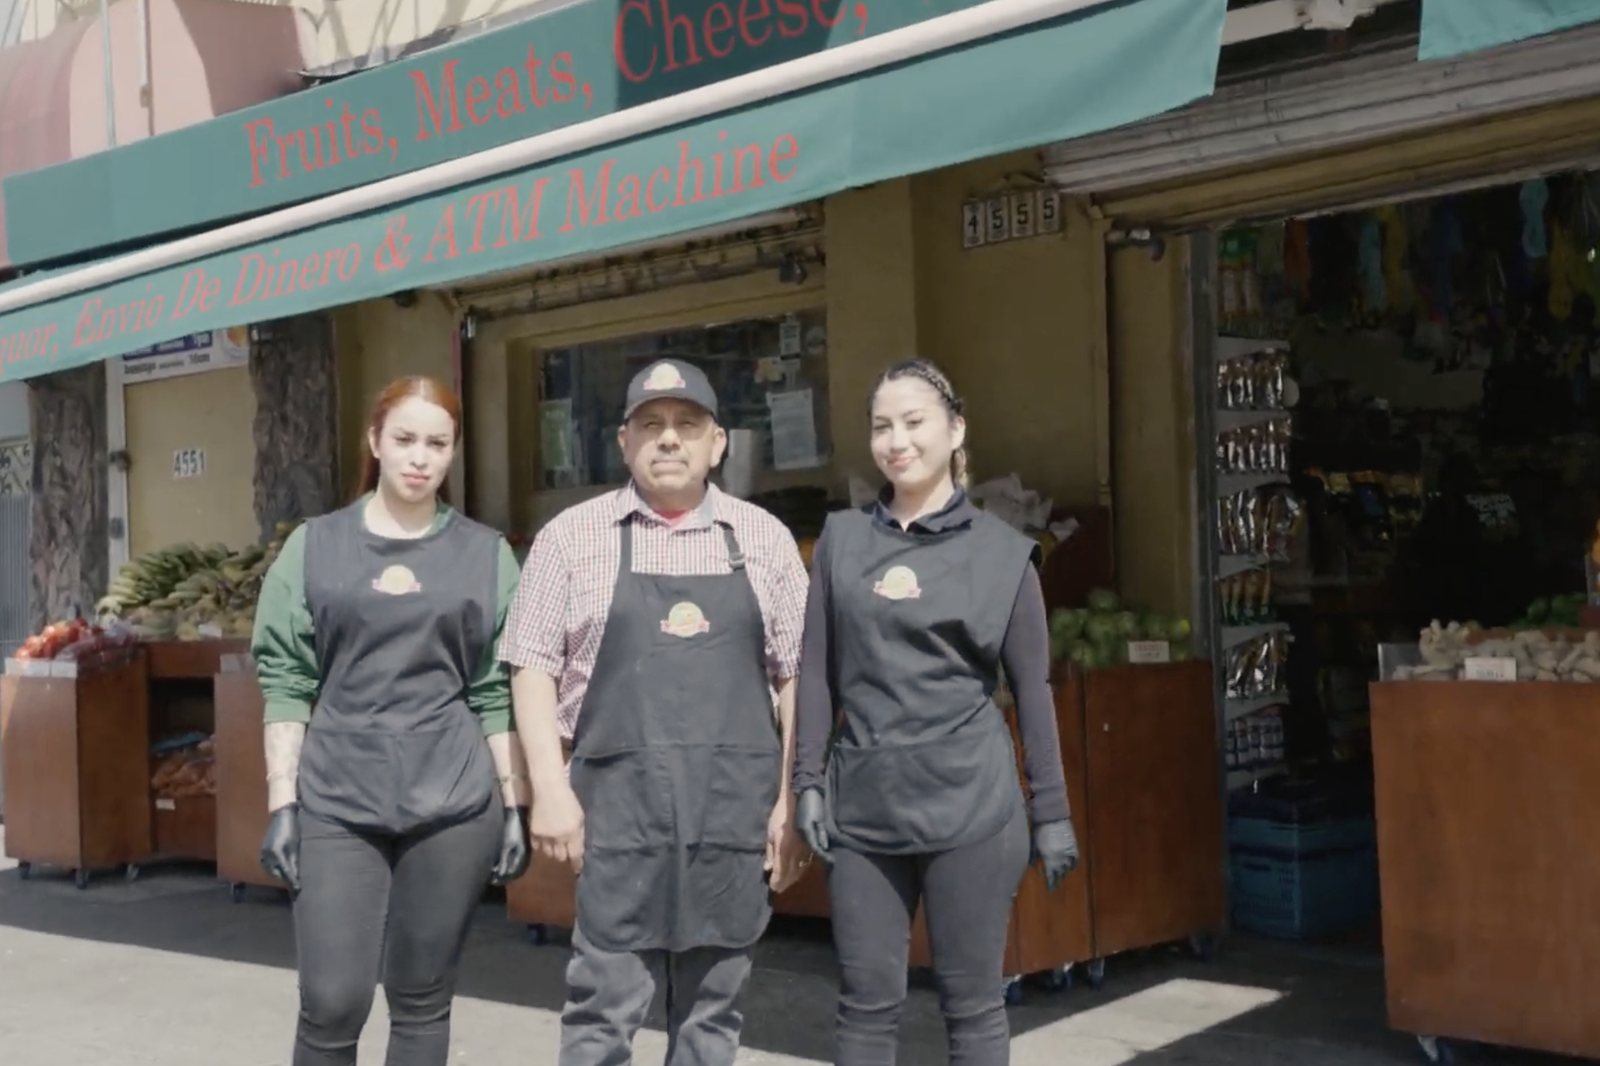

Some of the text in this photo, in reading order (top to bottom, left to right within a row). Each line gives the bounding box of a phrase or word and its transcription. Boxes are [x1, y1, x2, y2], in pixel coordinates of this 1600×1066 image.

[244, 0, 869, 191] Fruits, Meats, Cheese,
[72, 281, 165, 348] Envio
[169, 266, 222, 322] De
[225, 245, 362, 309] Dinero
[373, 212, 412, 275] &
[421, 177, 549, 264] ATM
[558, 130, 800, 233] Machine
[968, 198, 1055, 235] 4555
[174, 450, 205, 475] 4551
